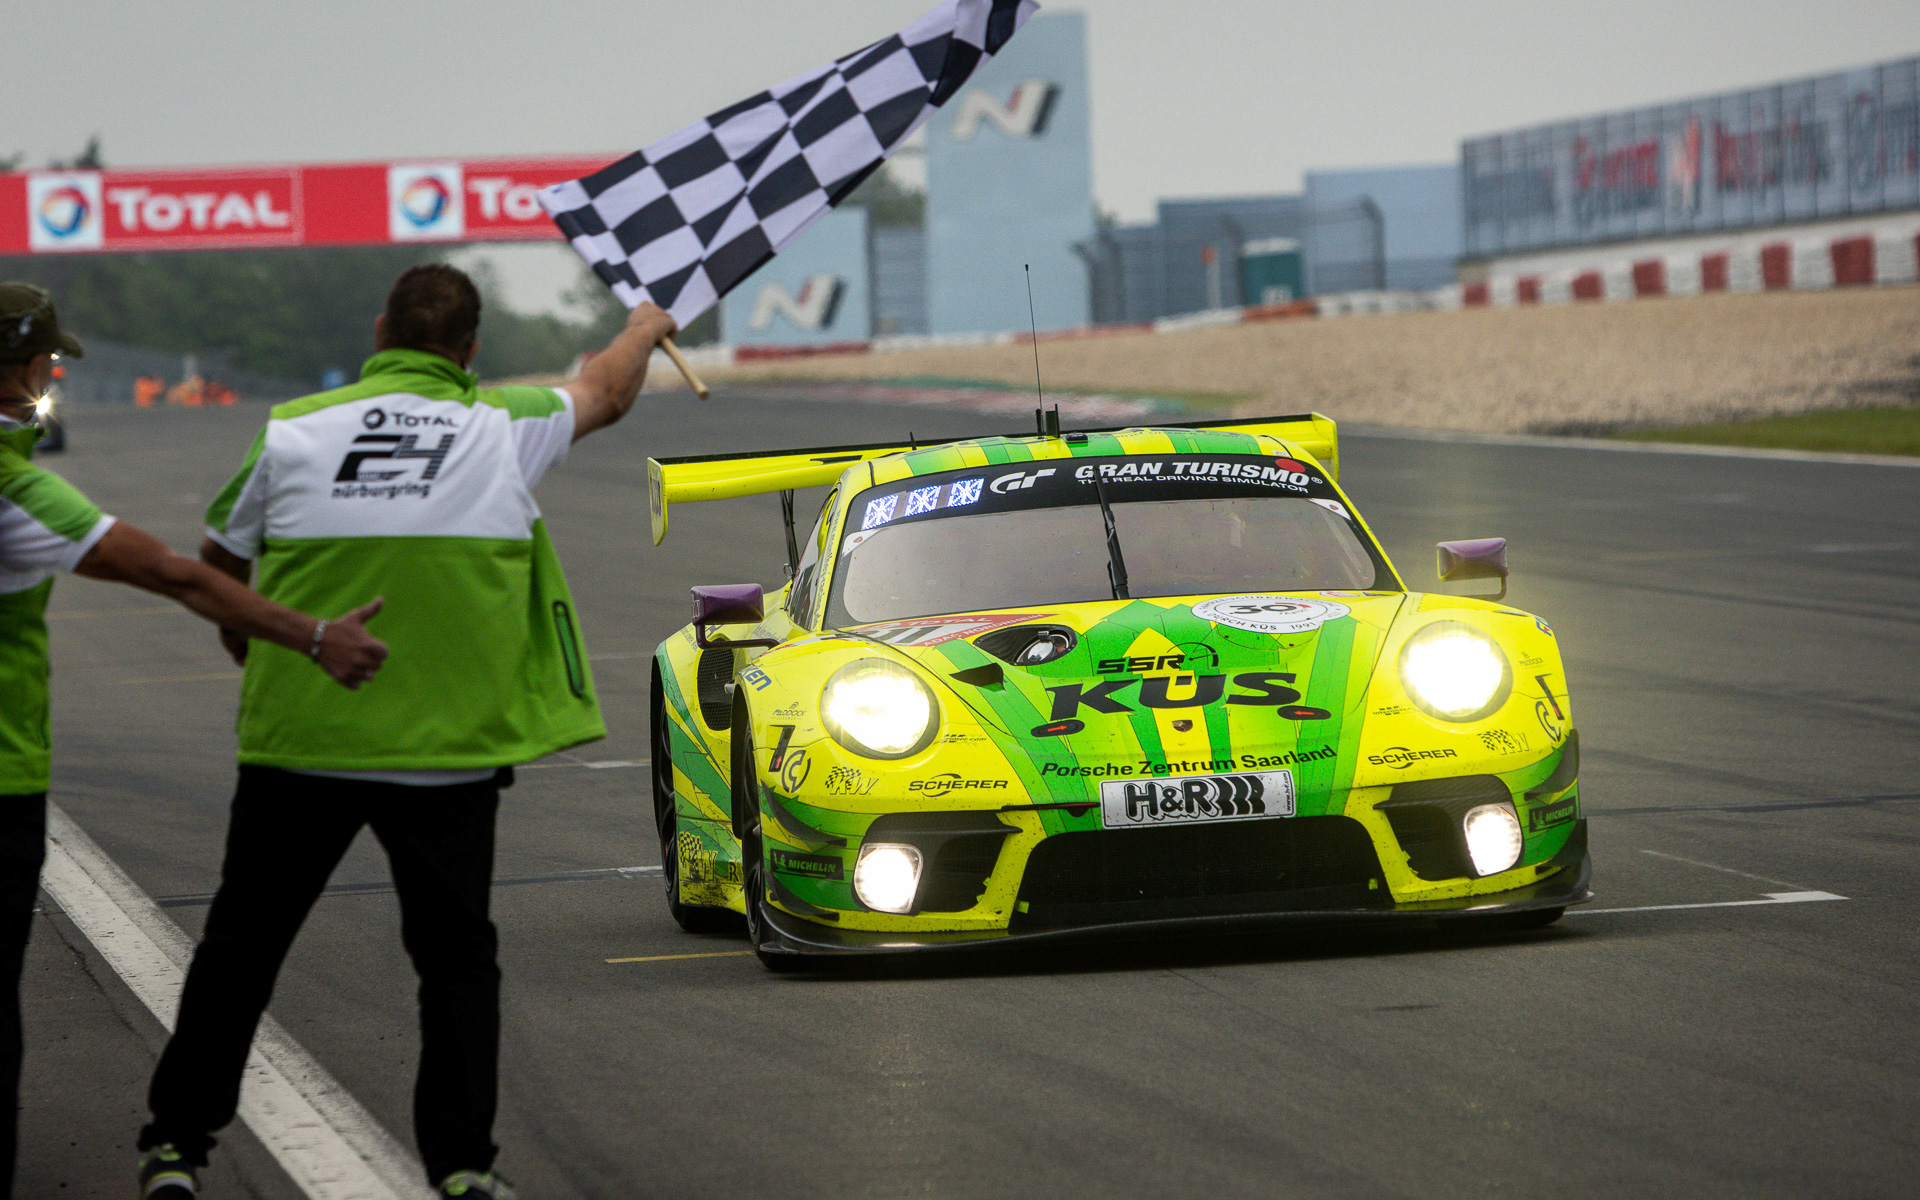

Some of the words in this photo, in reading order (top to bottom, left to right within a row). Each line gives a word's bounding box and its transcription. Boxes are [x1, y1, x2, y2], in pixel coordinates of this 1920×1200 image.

[106, 187, 290, 232] TOTAL
[467, 177, 541, 221] TO
[390, 412, 458, 427] TOTAL
[334, 433, 456, 482] 24
[1075, 462, 1163, 479] GRAN
[1172, 462, 1310, 486] TURISMO
[1113, 475, 1153, 483] REAL
[1221, 476, 1309, 494] SIMULATOR
[1229, 604, 1298, 615] 30
[1096, 654, 1187, 675] SSR
[1041, 762, 1133, 777] Porsche
[1139, 756, 1238, 775] Zentrum
[1241, 744, 1338, 768] Saarland
[1368, 748, 1458, 766] SCHERER
[908, 780, 1009, 792] SCHERER
[1123, 778, 1220, 823] H&R
[788, 858, 837, 874] MICHELIN
